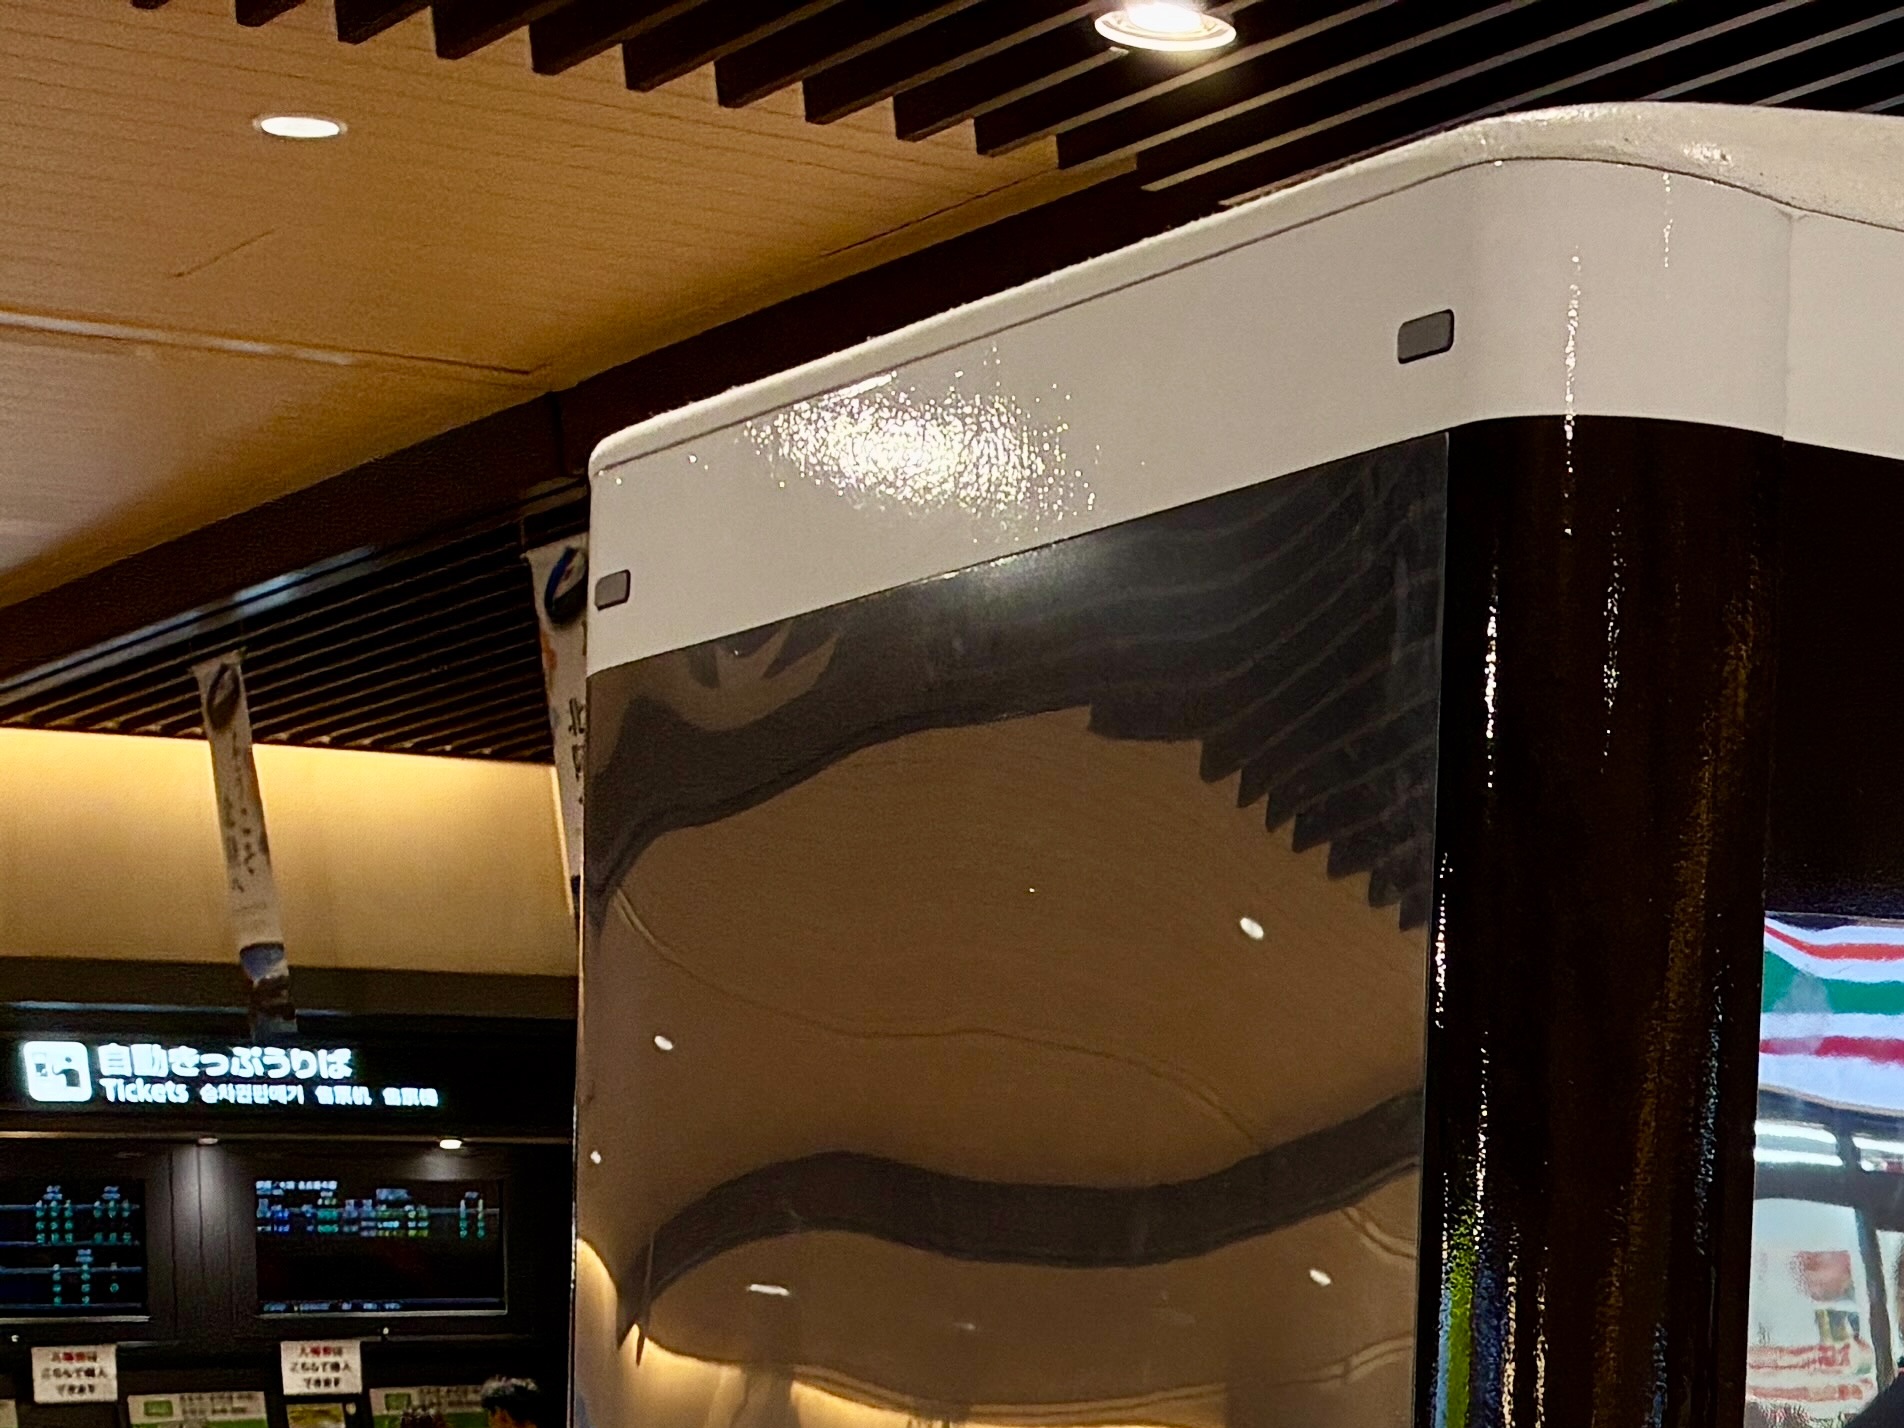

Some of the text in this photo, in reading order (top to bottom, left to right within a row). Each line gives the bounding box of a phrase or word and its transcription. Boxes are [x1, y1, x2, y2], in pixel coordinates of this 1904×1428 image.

[98, 1043, 353, 1080] 自動きっぷうりば
[99, 1078, 189, 1103] Tickets
